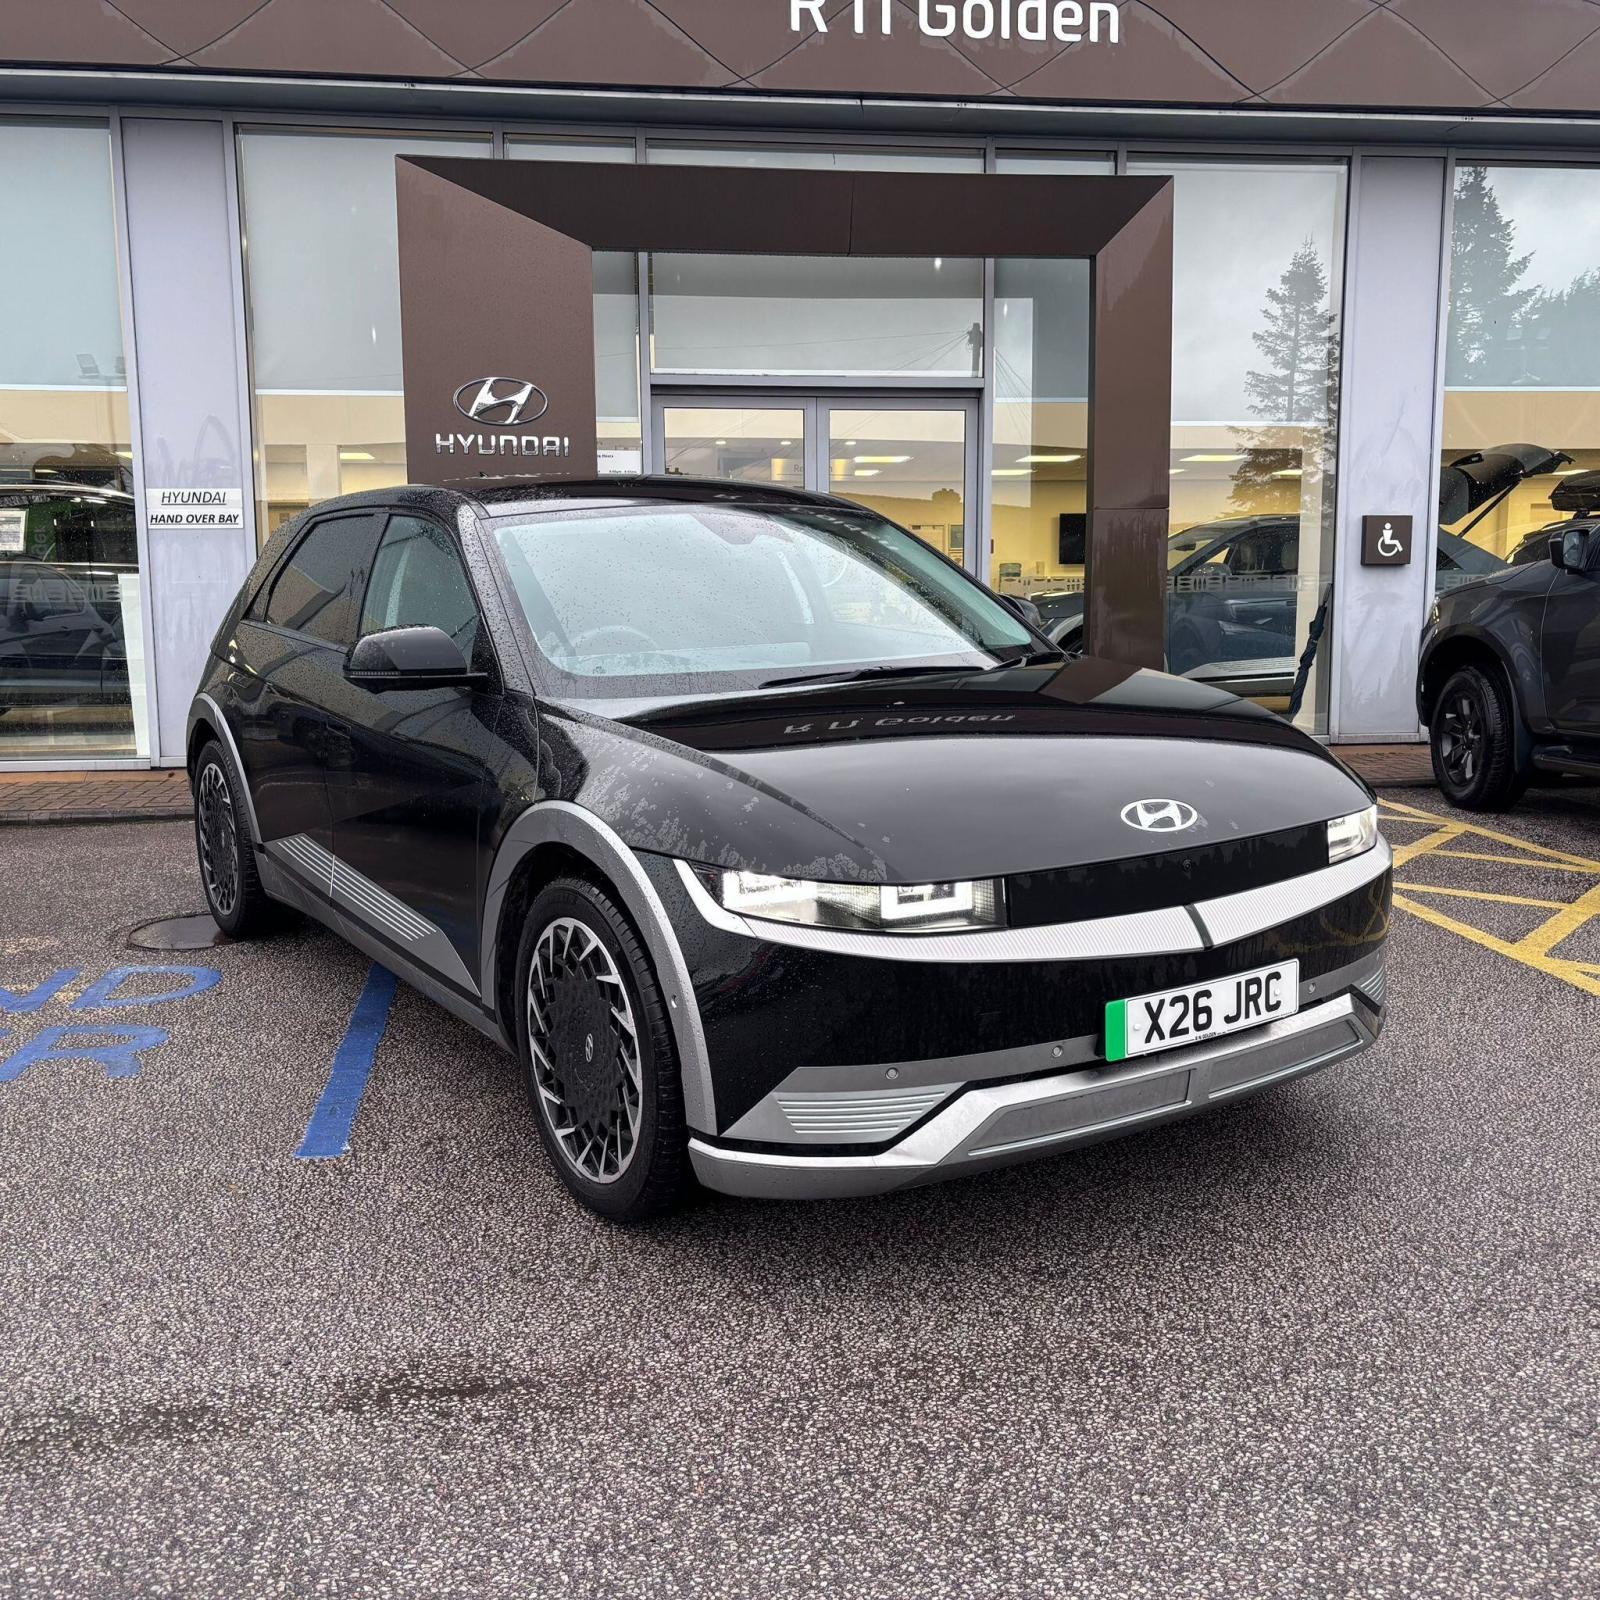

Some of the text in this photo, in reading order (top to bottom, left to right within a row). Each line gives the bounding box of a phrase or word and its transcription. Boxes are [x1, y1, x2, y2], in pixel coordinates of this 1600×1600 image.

[790, 0, 829, 33] R
[918, 0, 1120, 44] Golden
[435, 433, 570, 457] HYUNDAI
[160, 490, 227, 504] HYUNDAI
[149, 513, 240, 525] HAND OVER BAY
[1143, 971, 1282, 1044] X26 JRC
